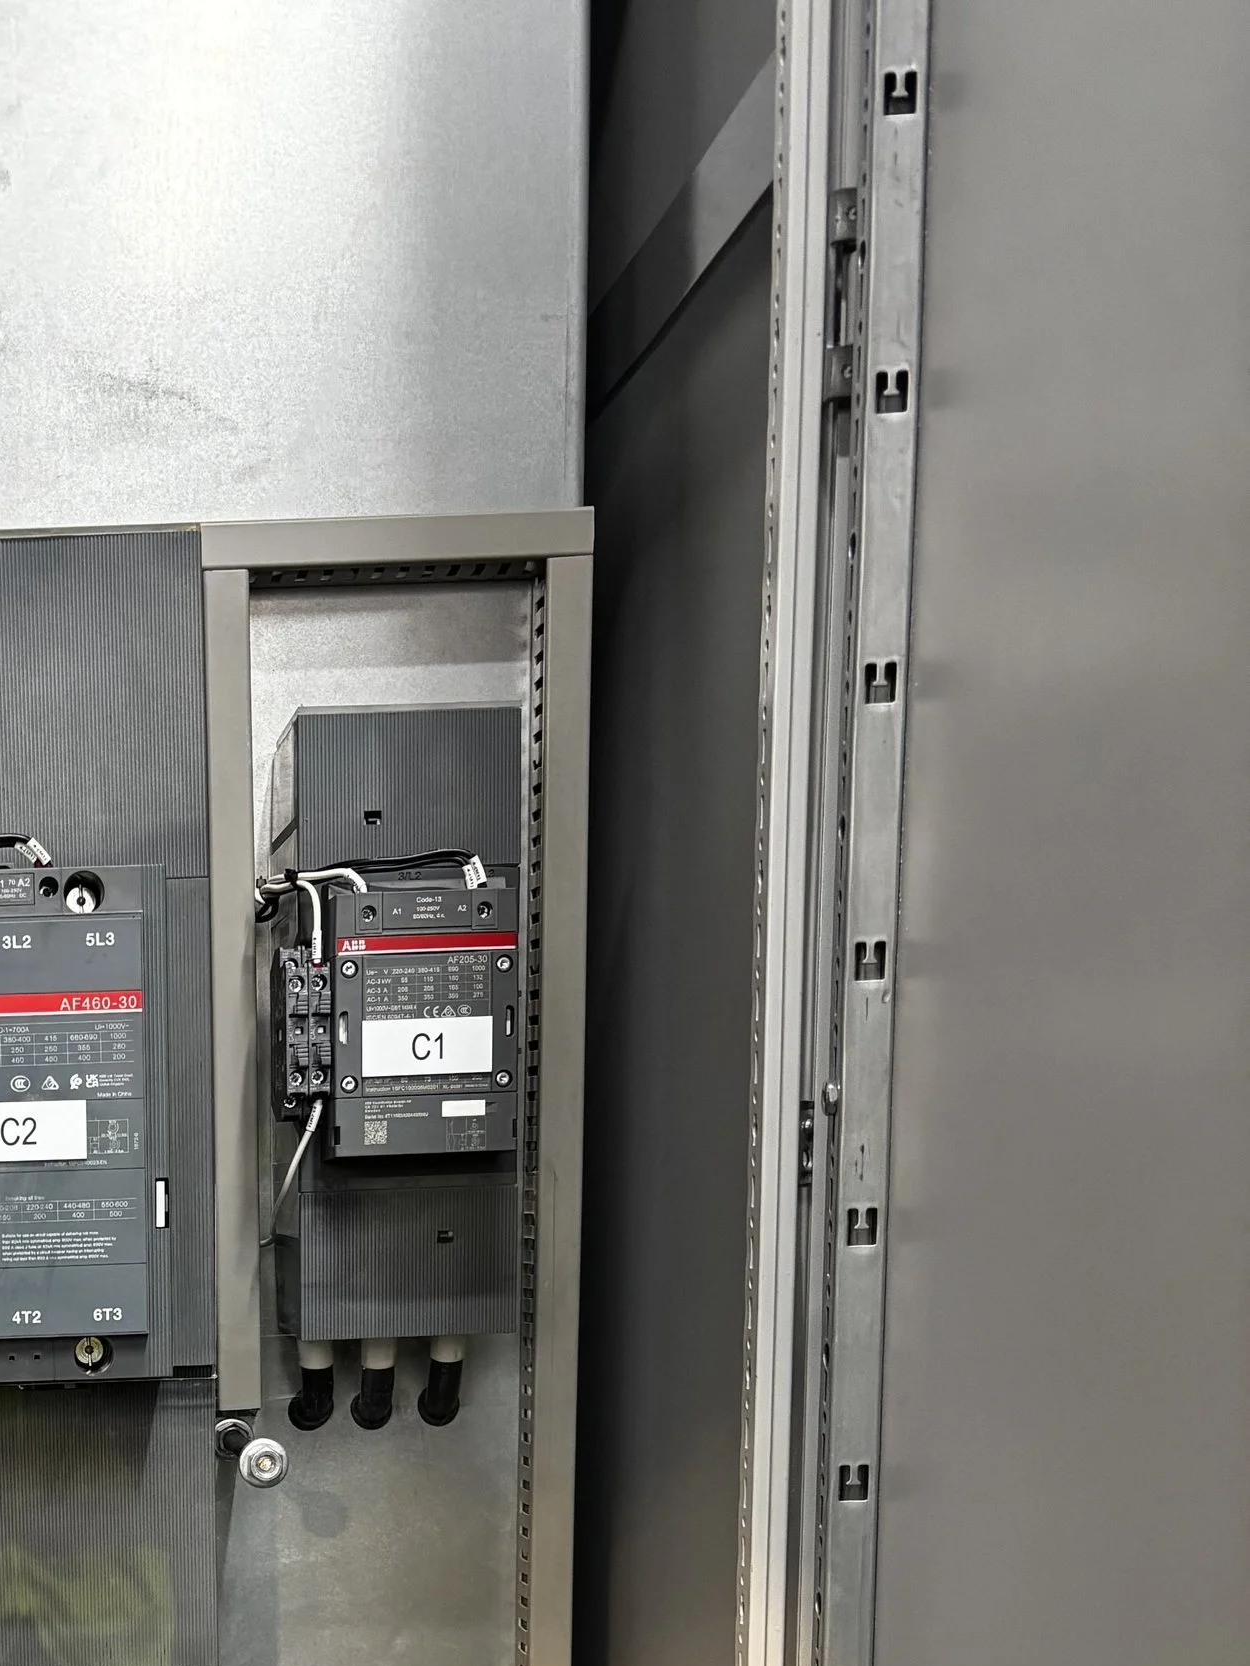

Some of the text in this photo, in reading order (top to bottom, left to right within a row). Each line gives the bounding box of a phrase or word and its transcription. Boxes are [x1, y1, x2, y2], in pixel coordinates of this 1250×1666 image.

[17, 878, 31, 887] A2
[398, 872, 422, 881] 3/L2
[2, 935, 32, 949] 3L2
[85, 932, 115, 947] 5L3
[342, 939, 366, 951] ABB
[447, 955, 488, 964] AF205-30
[59, 996, 137, 1011] AF460-30
[411, 1032, 443, 1061] C1
[0, 1117, 37, 1146] C2
[26, 1203, 54, 1211] 220-240
[12, 1311, 42, 1324] 4T2
[93, 1308, 123, 1322] 6T3
